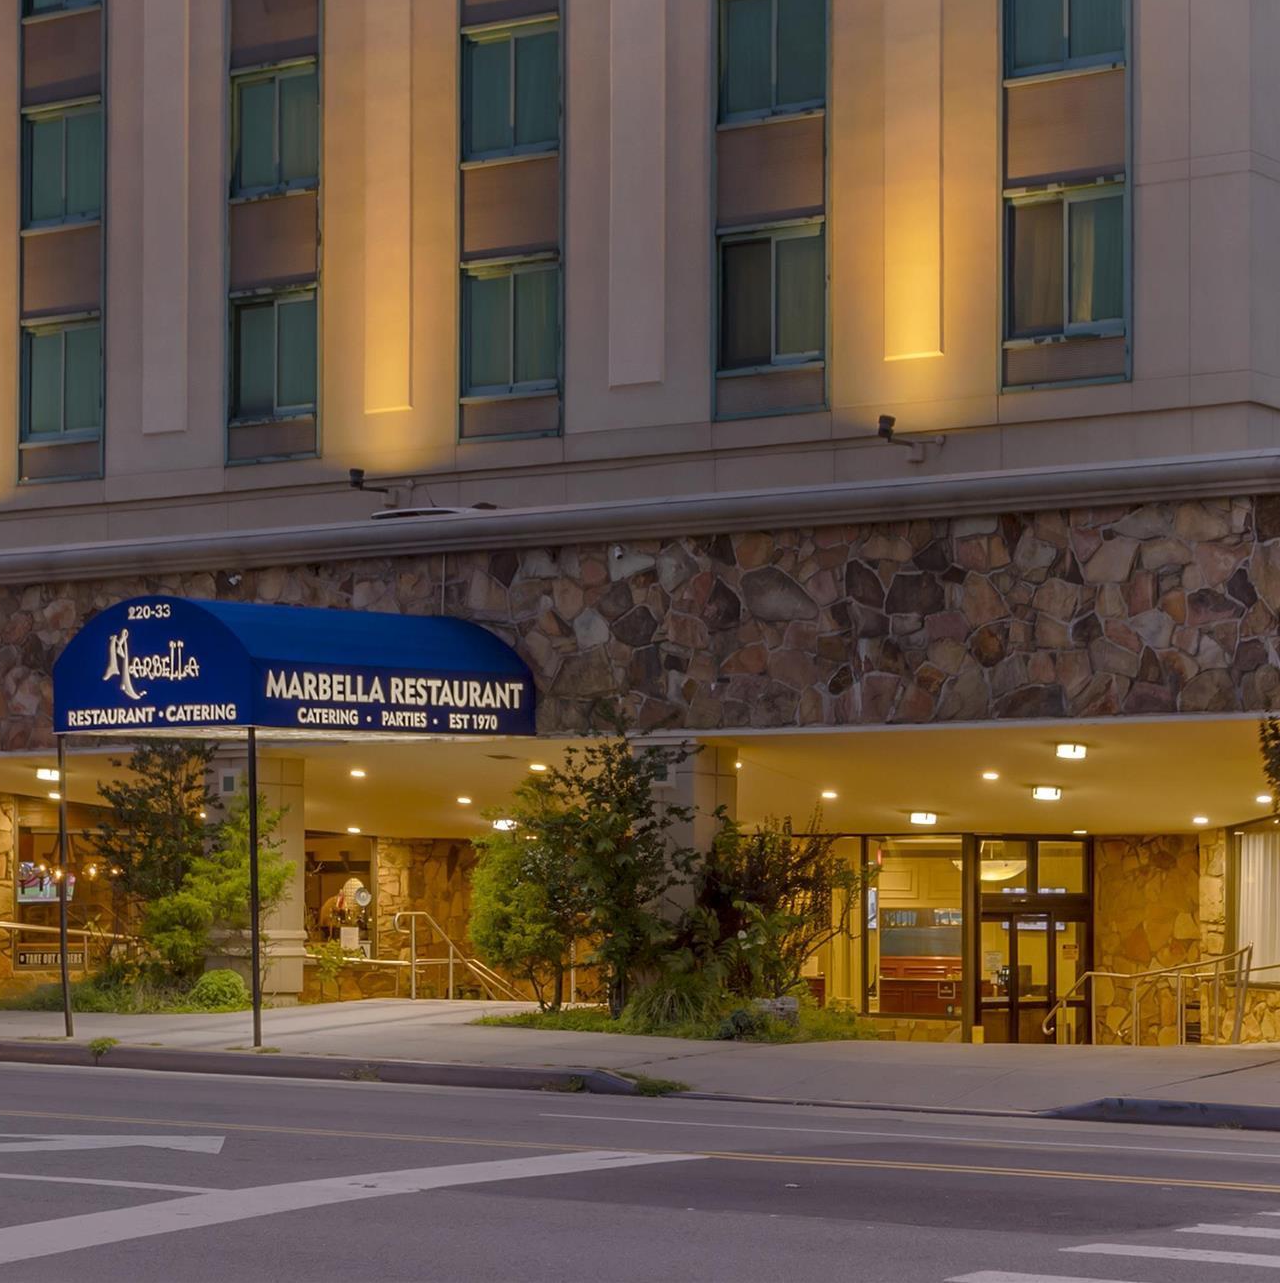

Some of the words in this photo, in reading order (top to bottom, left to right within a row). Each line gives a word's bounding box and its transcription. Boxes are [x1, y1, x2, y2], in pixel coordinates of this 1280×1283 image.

[128, 604, 171, 620] 220-33
[266, 669, 385, 704] MARBELLA
[390, 677, 523, 709] RESTAURANT
[68, 706, 155, 727] RESTAURANT
[165, 704, 237, 721] CATERING
[297, 707, 358, 725] CATERING
[381, 710, 427, 728] PARTIES
[449, 713, 470, 729] EST
[472, 715, 498, 730] 1970
[25, 953, 42, 964] TAKE
[43, 953, 56, 964] OUT
[57, 953, 82, 964] ODERS
